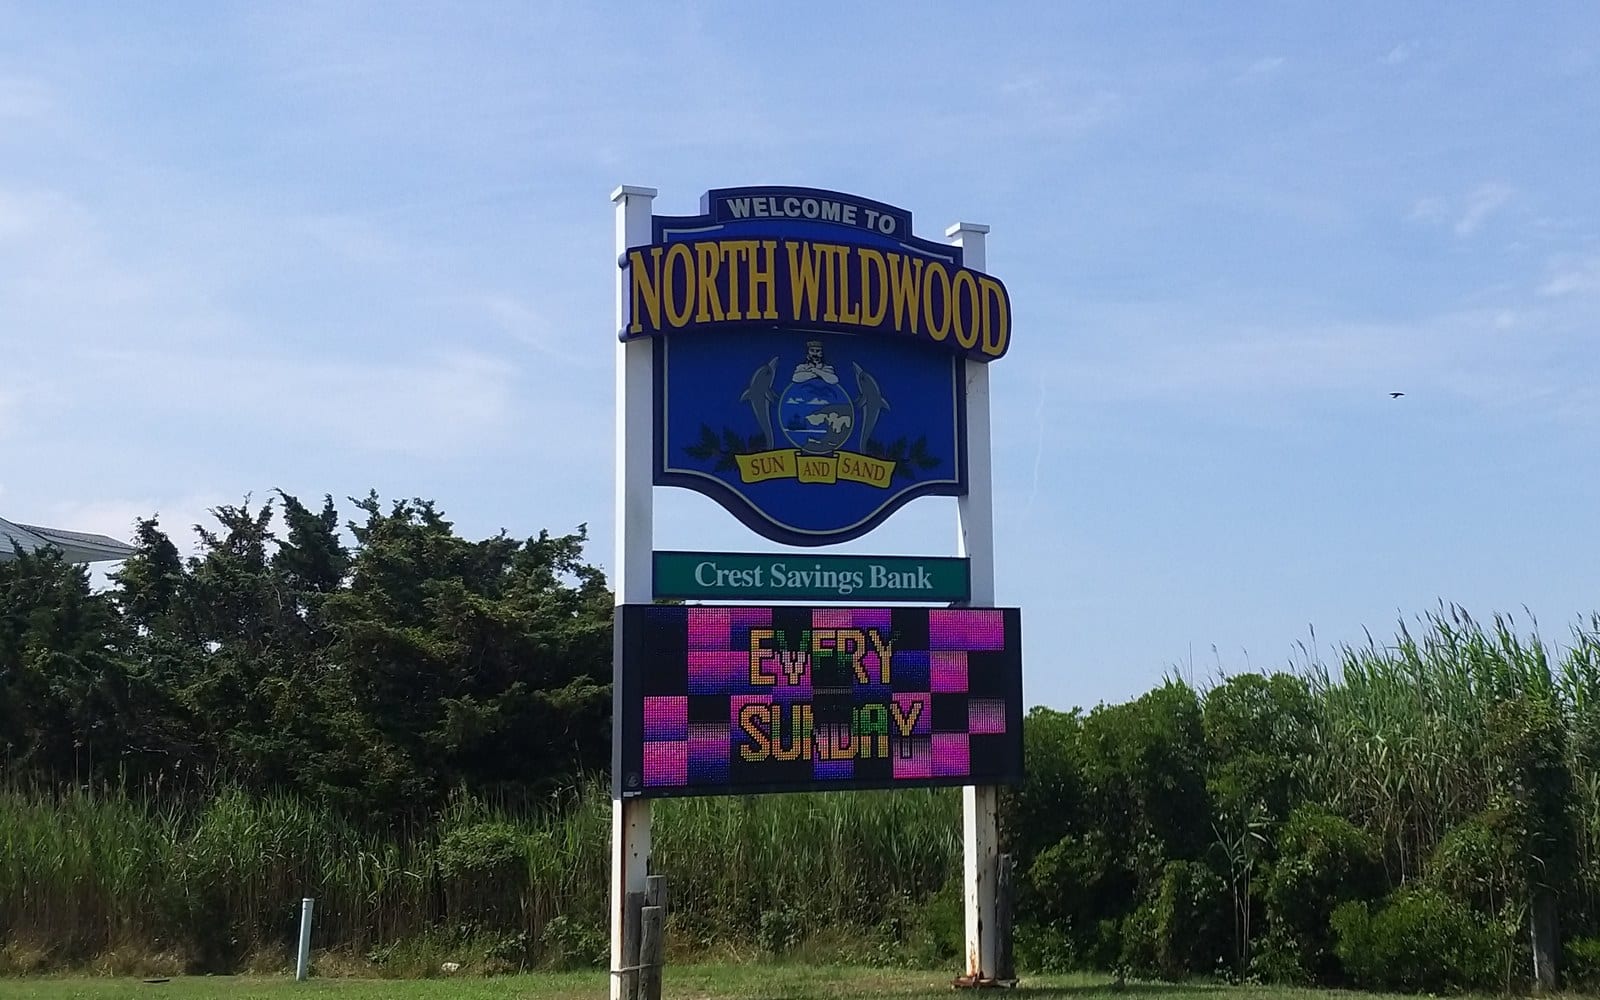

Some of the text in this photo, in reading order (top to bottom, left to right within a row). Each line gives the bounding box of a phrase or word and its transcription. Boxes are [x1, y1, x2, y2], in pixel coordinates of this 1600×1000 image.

[727, 198, 897, 235] WELCOME TO
[629, 240, 1010, 356] NORTH WILDWOOD
[751, 456, 886, 482] SUN AND SAND
[694, 562, 933, 595] Crest Savings Bank
[740, 702, 923, 761] SUNDAY
